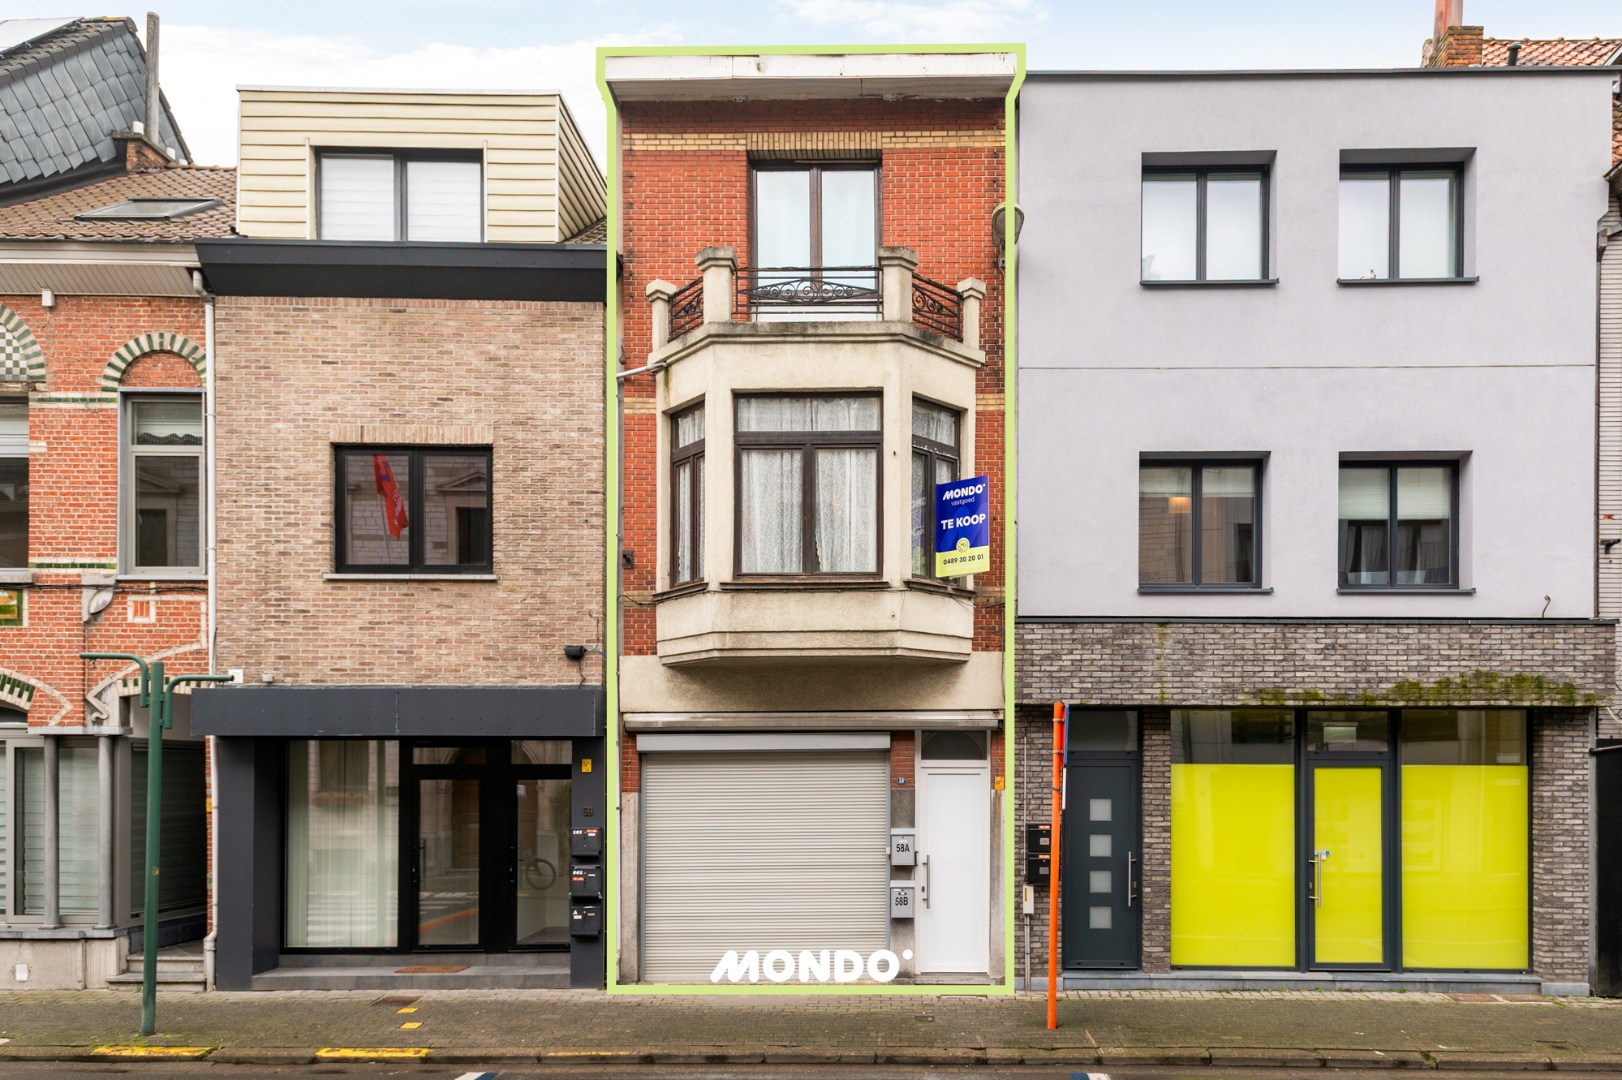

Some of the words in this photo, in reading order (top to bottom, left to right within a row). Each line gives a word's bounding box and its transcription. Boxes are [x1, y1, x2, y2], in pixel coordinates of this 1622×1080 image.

[942, 483, 984, 501] MONDO
[941, 519, 954, 530] TE
[956, 513, 986, 528] KOOP
[968, 554, 976, 562] 20
[896, 843, 910, 853] 58A
[895, 896, 909, 906] 58B
